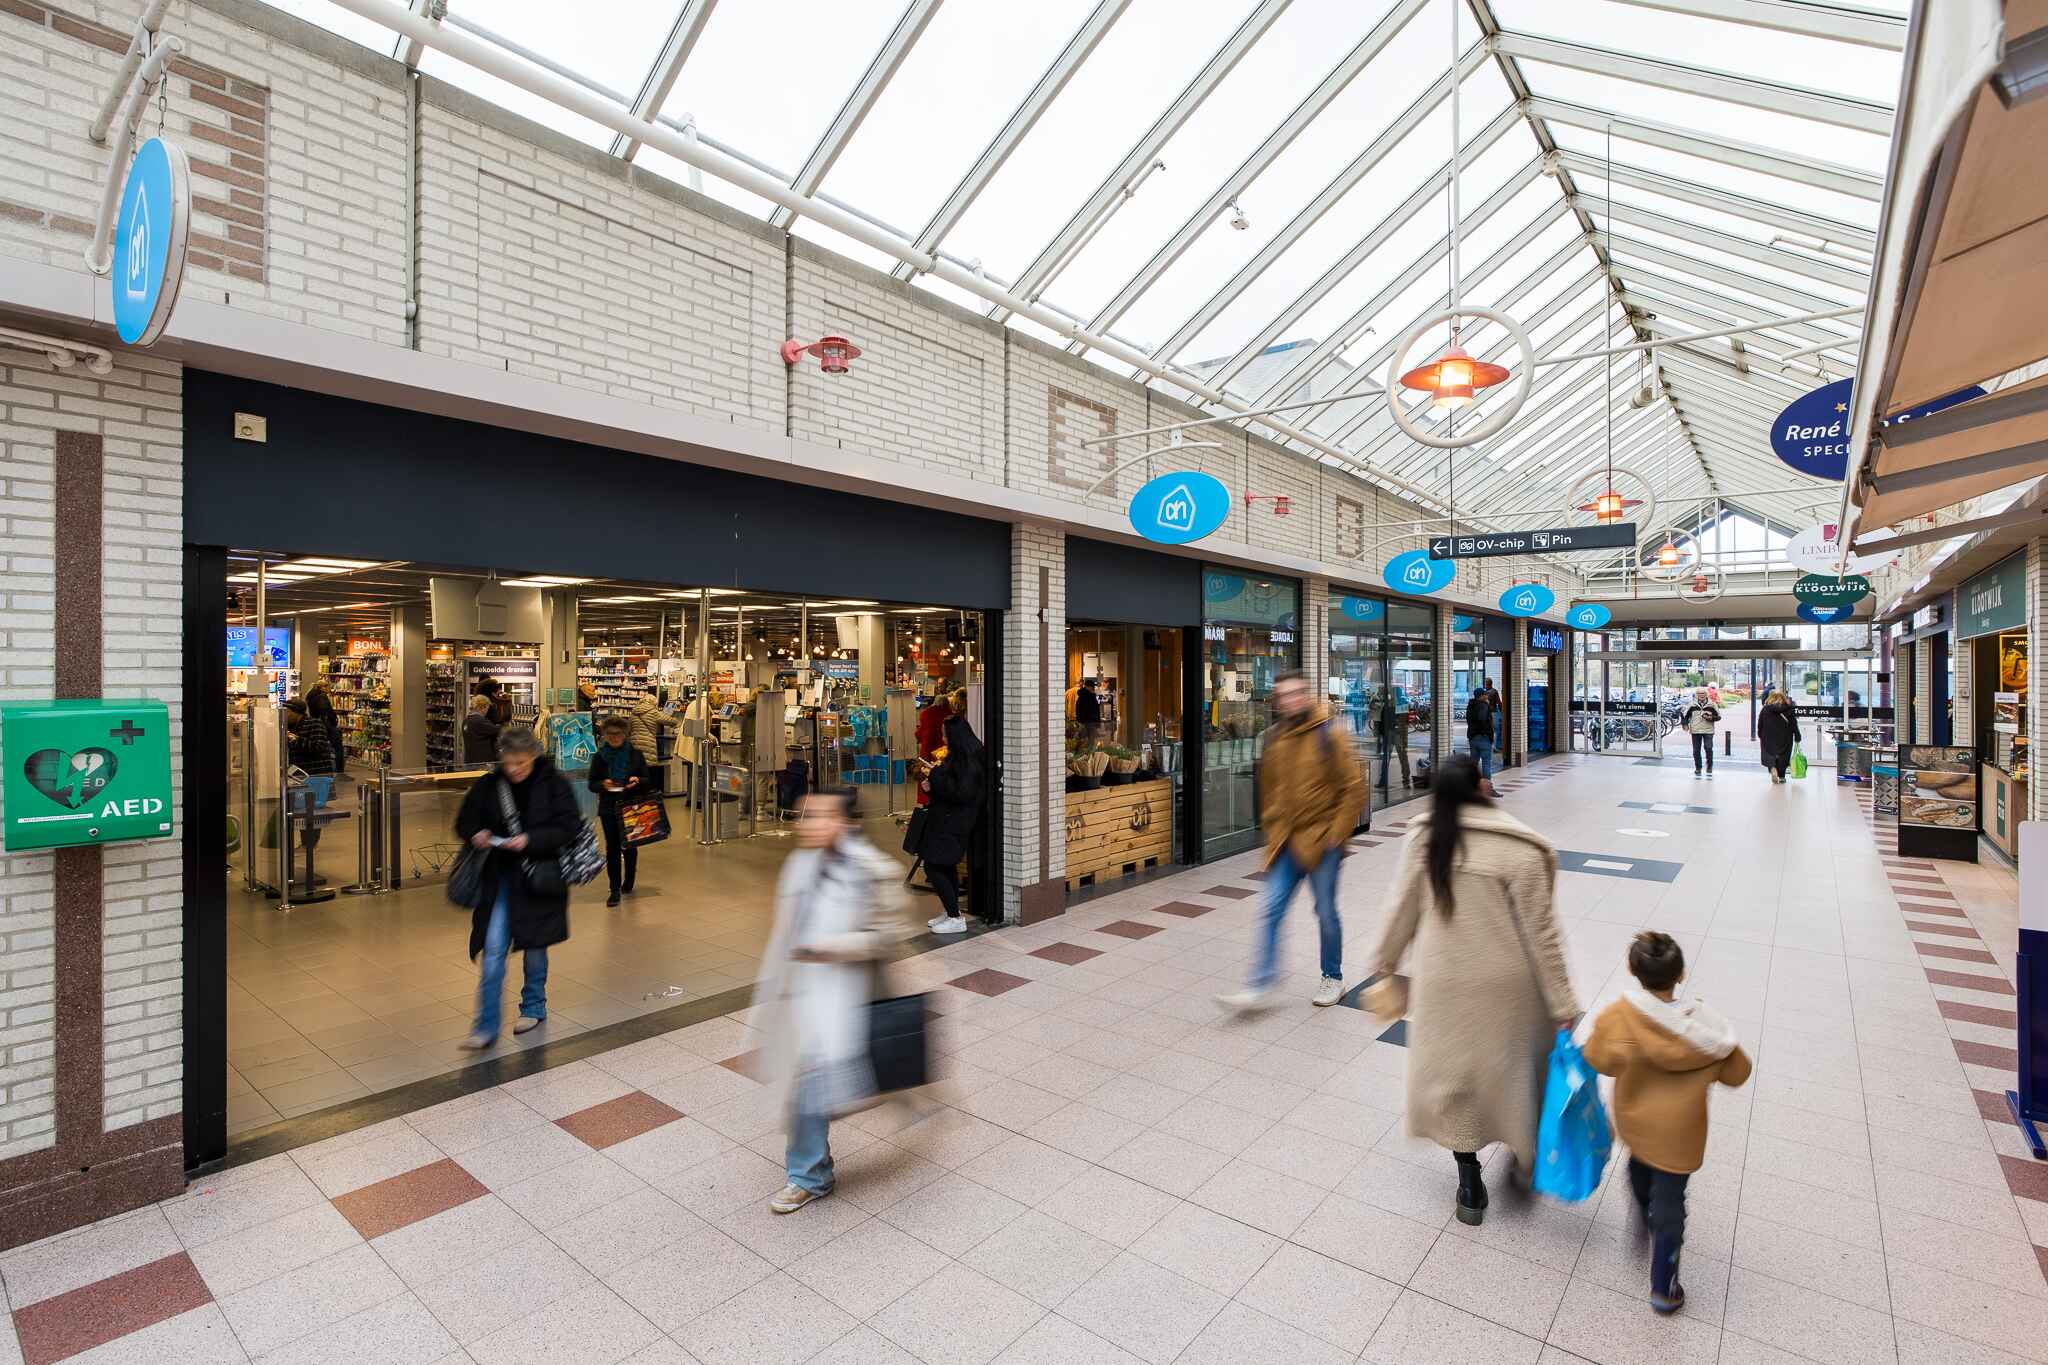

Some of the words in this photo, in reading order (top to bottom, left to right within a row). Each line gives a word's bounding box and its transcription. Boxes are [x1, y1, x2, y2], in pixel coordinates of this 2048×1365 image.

[1785, 420, 1841, 441] René
[1476, 538, 1525, 550] OV-chip
[1552, 535, 1572, 545] Pin
[1796, 584, 1867, 593] KLOOTWIJK
[1532, 627, 1549, 648] Albert
[1549, 630, 1563, 655] Heijn
[101, 798, 163, 818] AED
